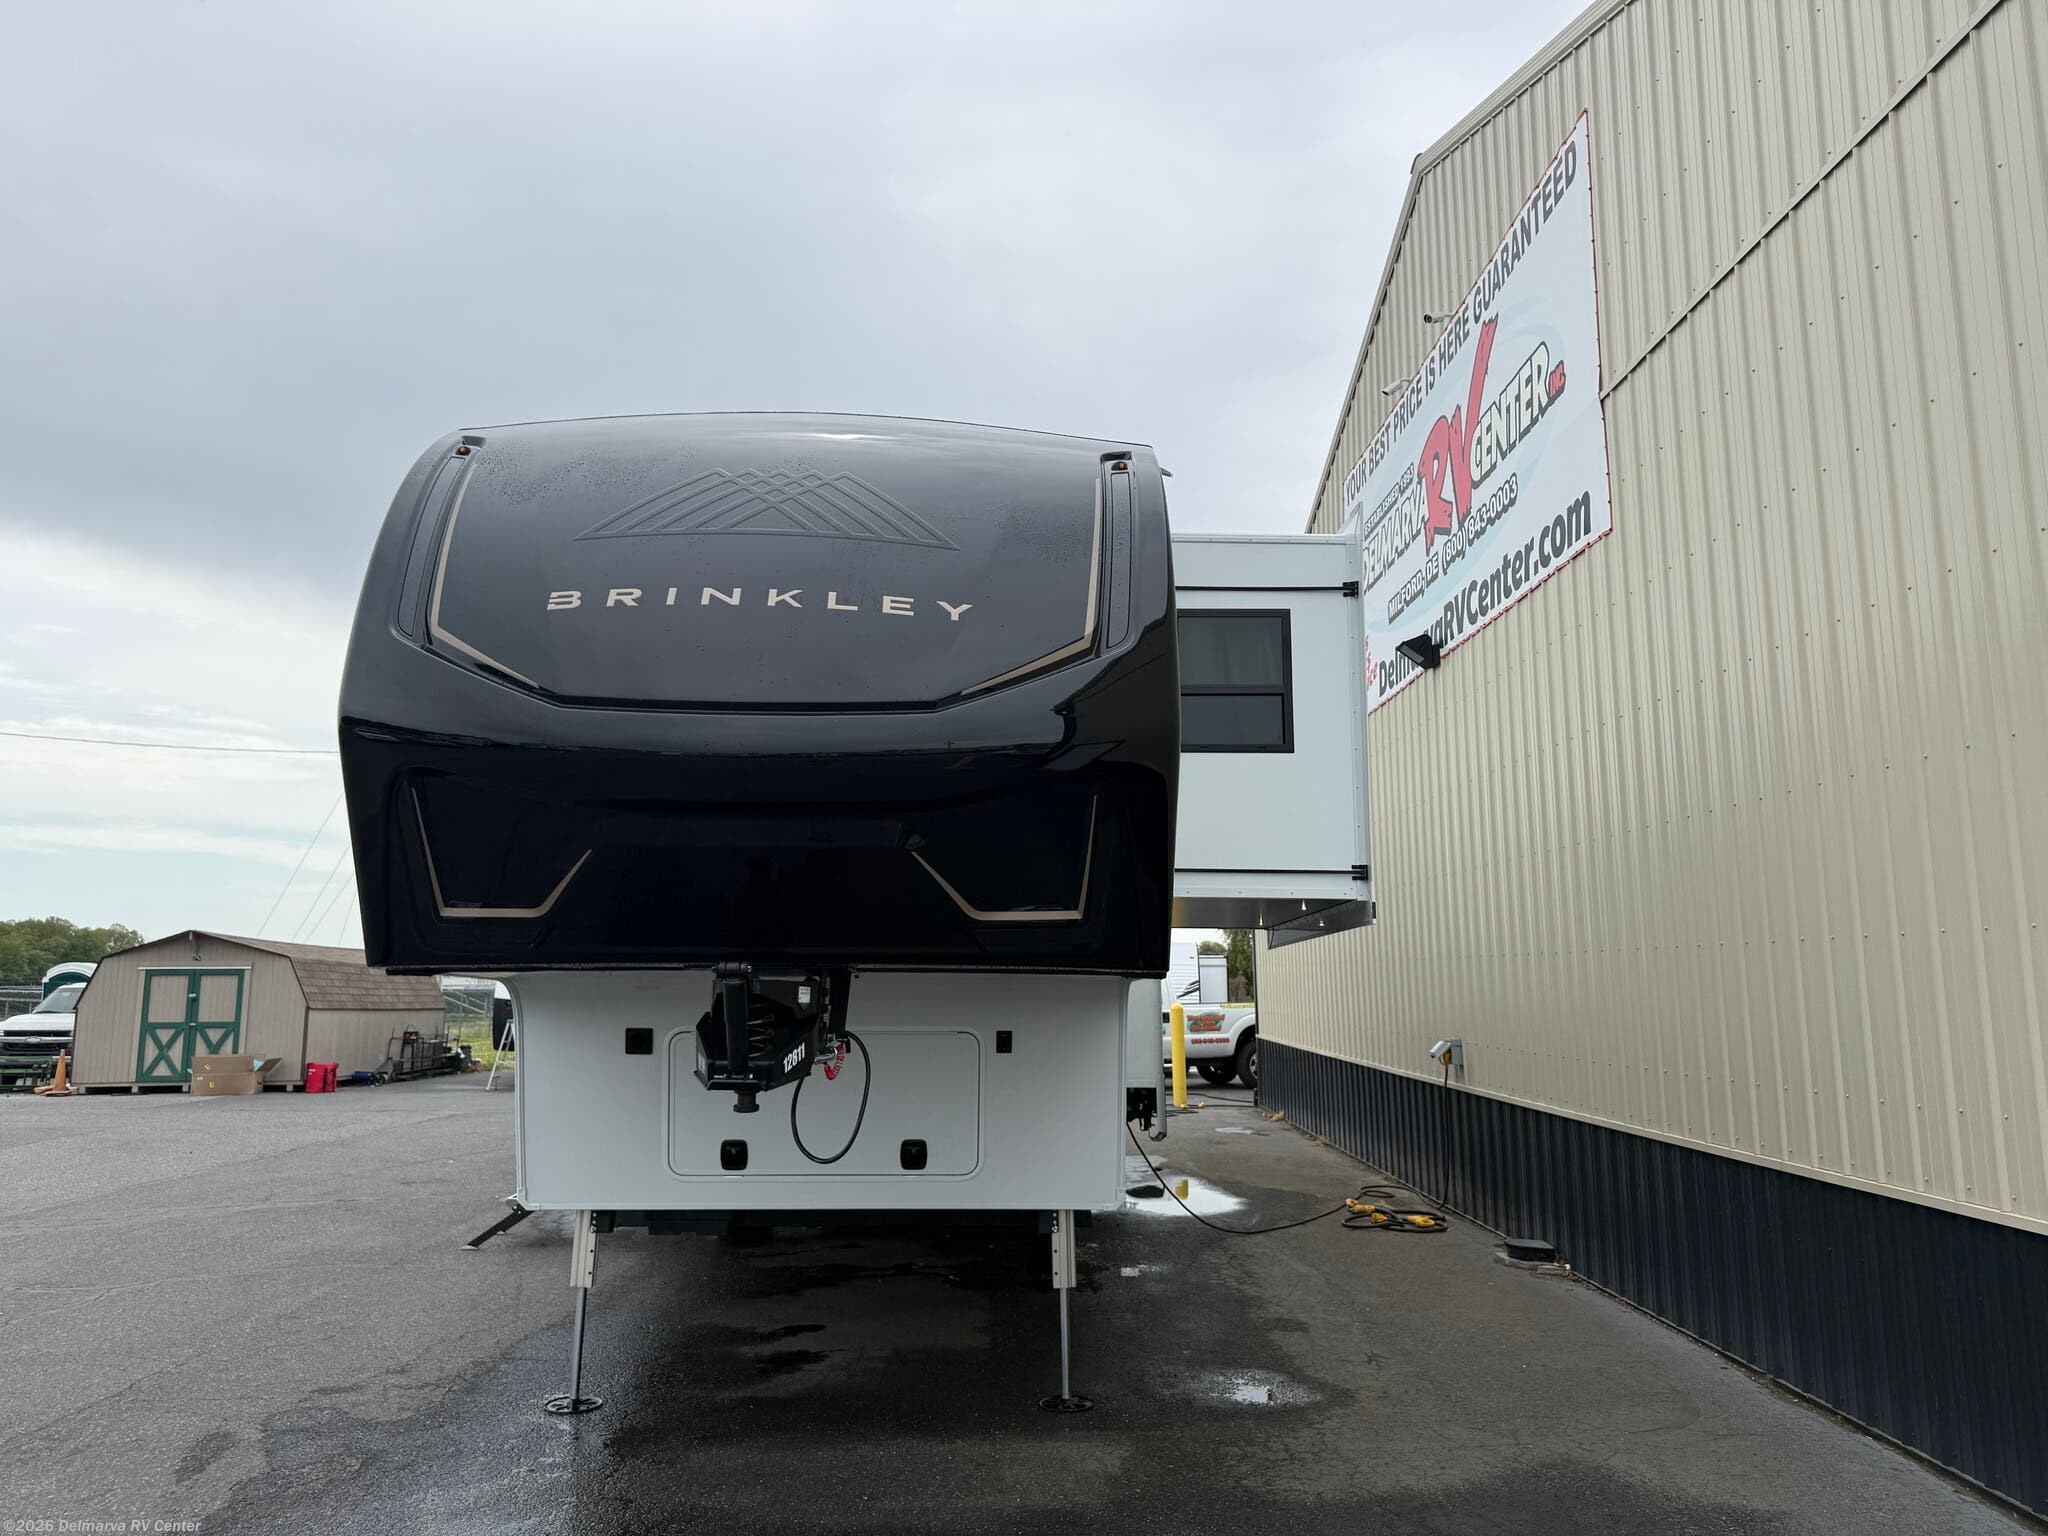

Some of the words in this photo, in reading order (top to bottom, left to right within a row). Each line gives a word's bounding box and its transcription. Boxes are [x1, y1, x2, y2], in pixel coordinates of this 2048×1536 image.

[1345, 457, 1367, 506] YOUR
[1369, 421, 1391, 477] BEST
[1393, 376, 1423, 443] PRICE
[1425, 355, 1436, 397] IS
[1438, 301, 1470, 376] HERE
[1473, 140, 1577, 325] GUARANTEED
[1418, 312, 1499, 554] RV
[1470, 341, 1551, 488] CENTER
[1364, 481, 1399, 537] ESTABLISHED
[547, 587, 973, 621] BRINKLEY
[1388, 569, 1425, 624] MILFORD,
[1425, 552, 1439, 588] DE
[783, 1041, 805, 1073] 12811
